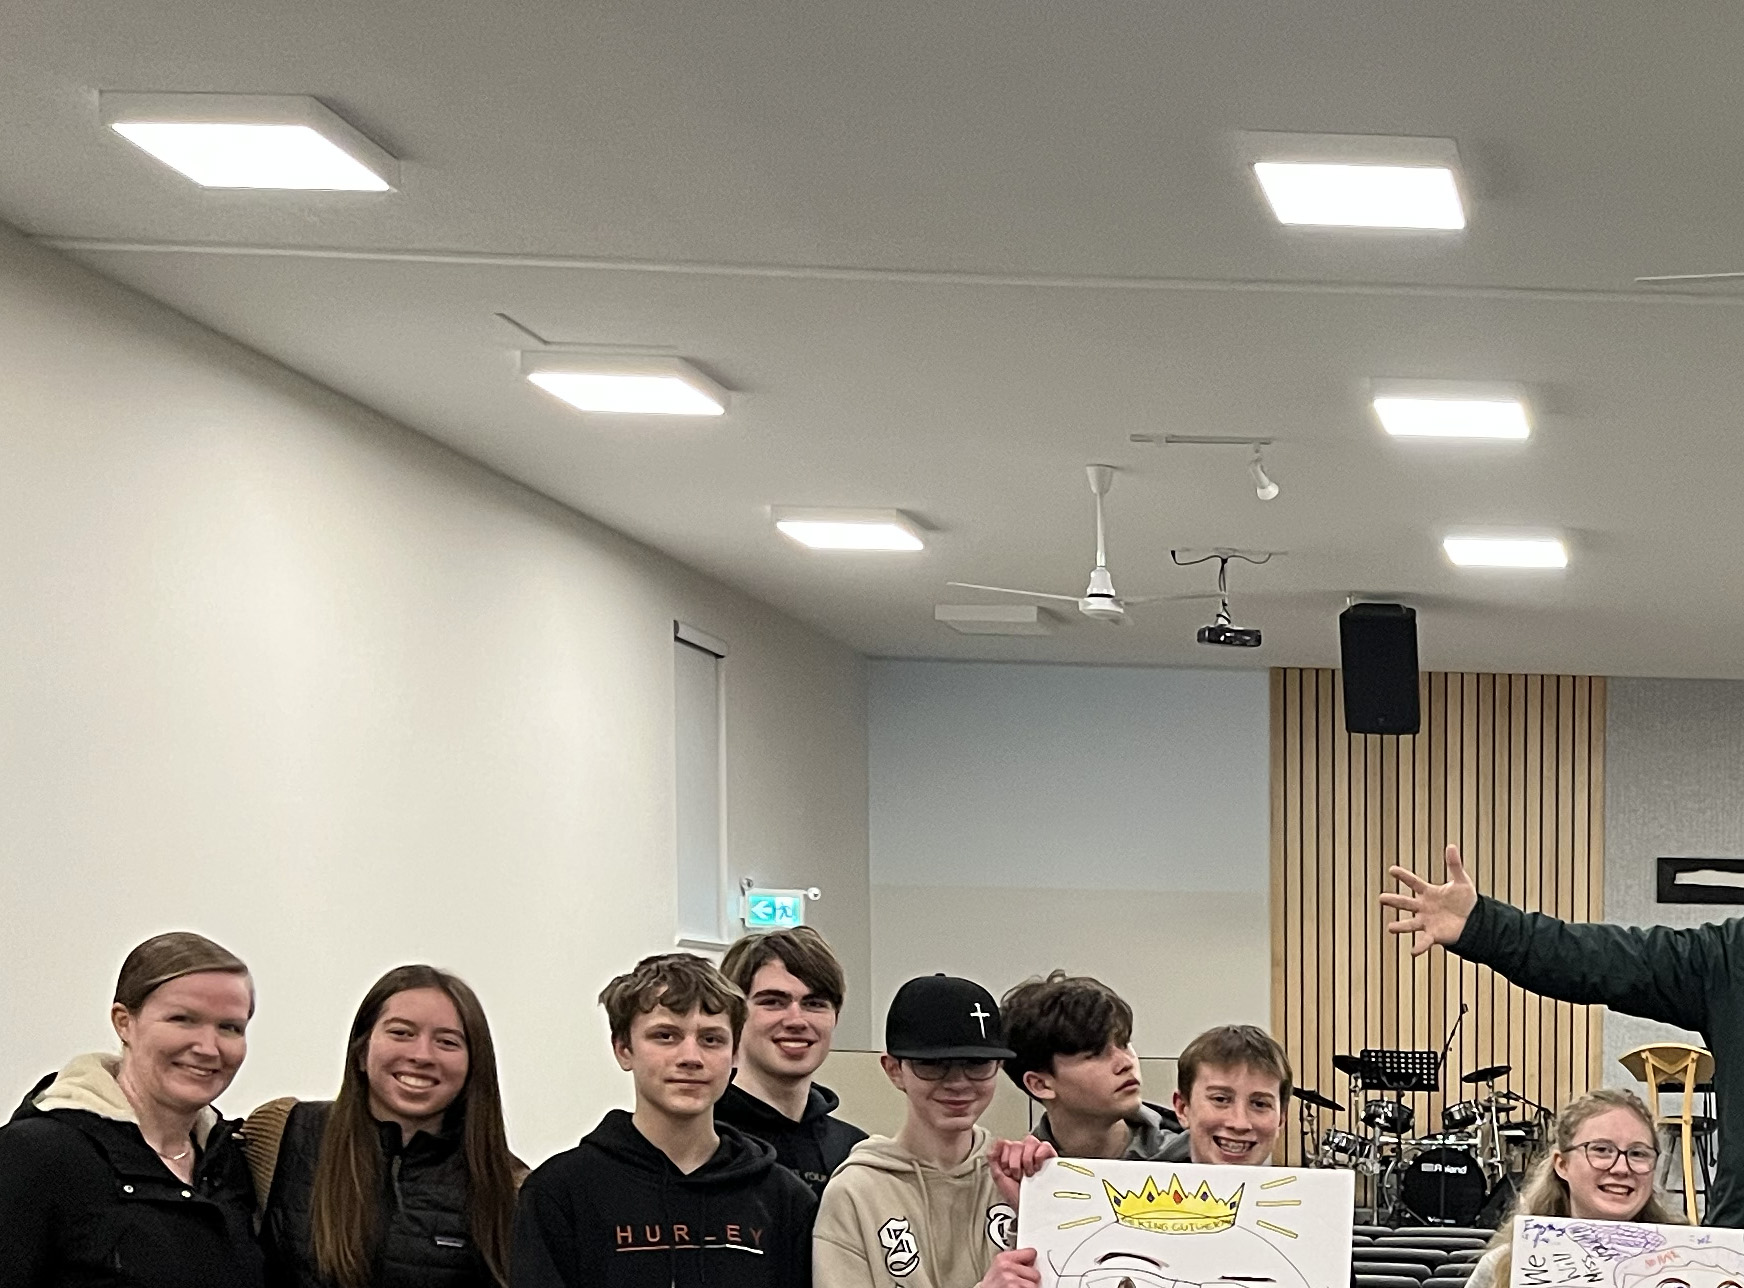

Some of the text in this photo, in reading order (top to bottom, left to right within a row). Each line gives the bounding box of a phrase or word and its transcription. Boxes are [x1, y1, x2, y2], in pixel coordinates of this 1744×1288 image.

[616, 1224, 763, 1245] HUREY
[1138, 1220, 1168, 1231] KING
[1520, 1254, 1557, 1286] We
